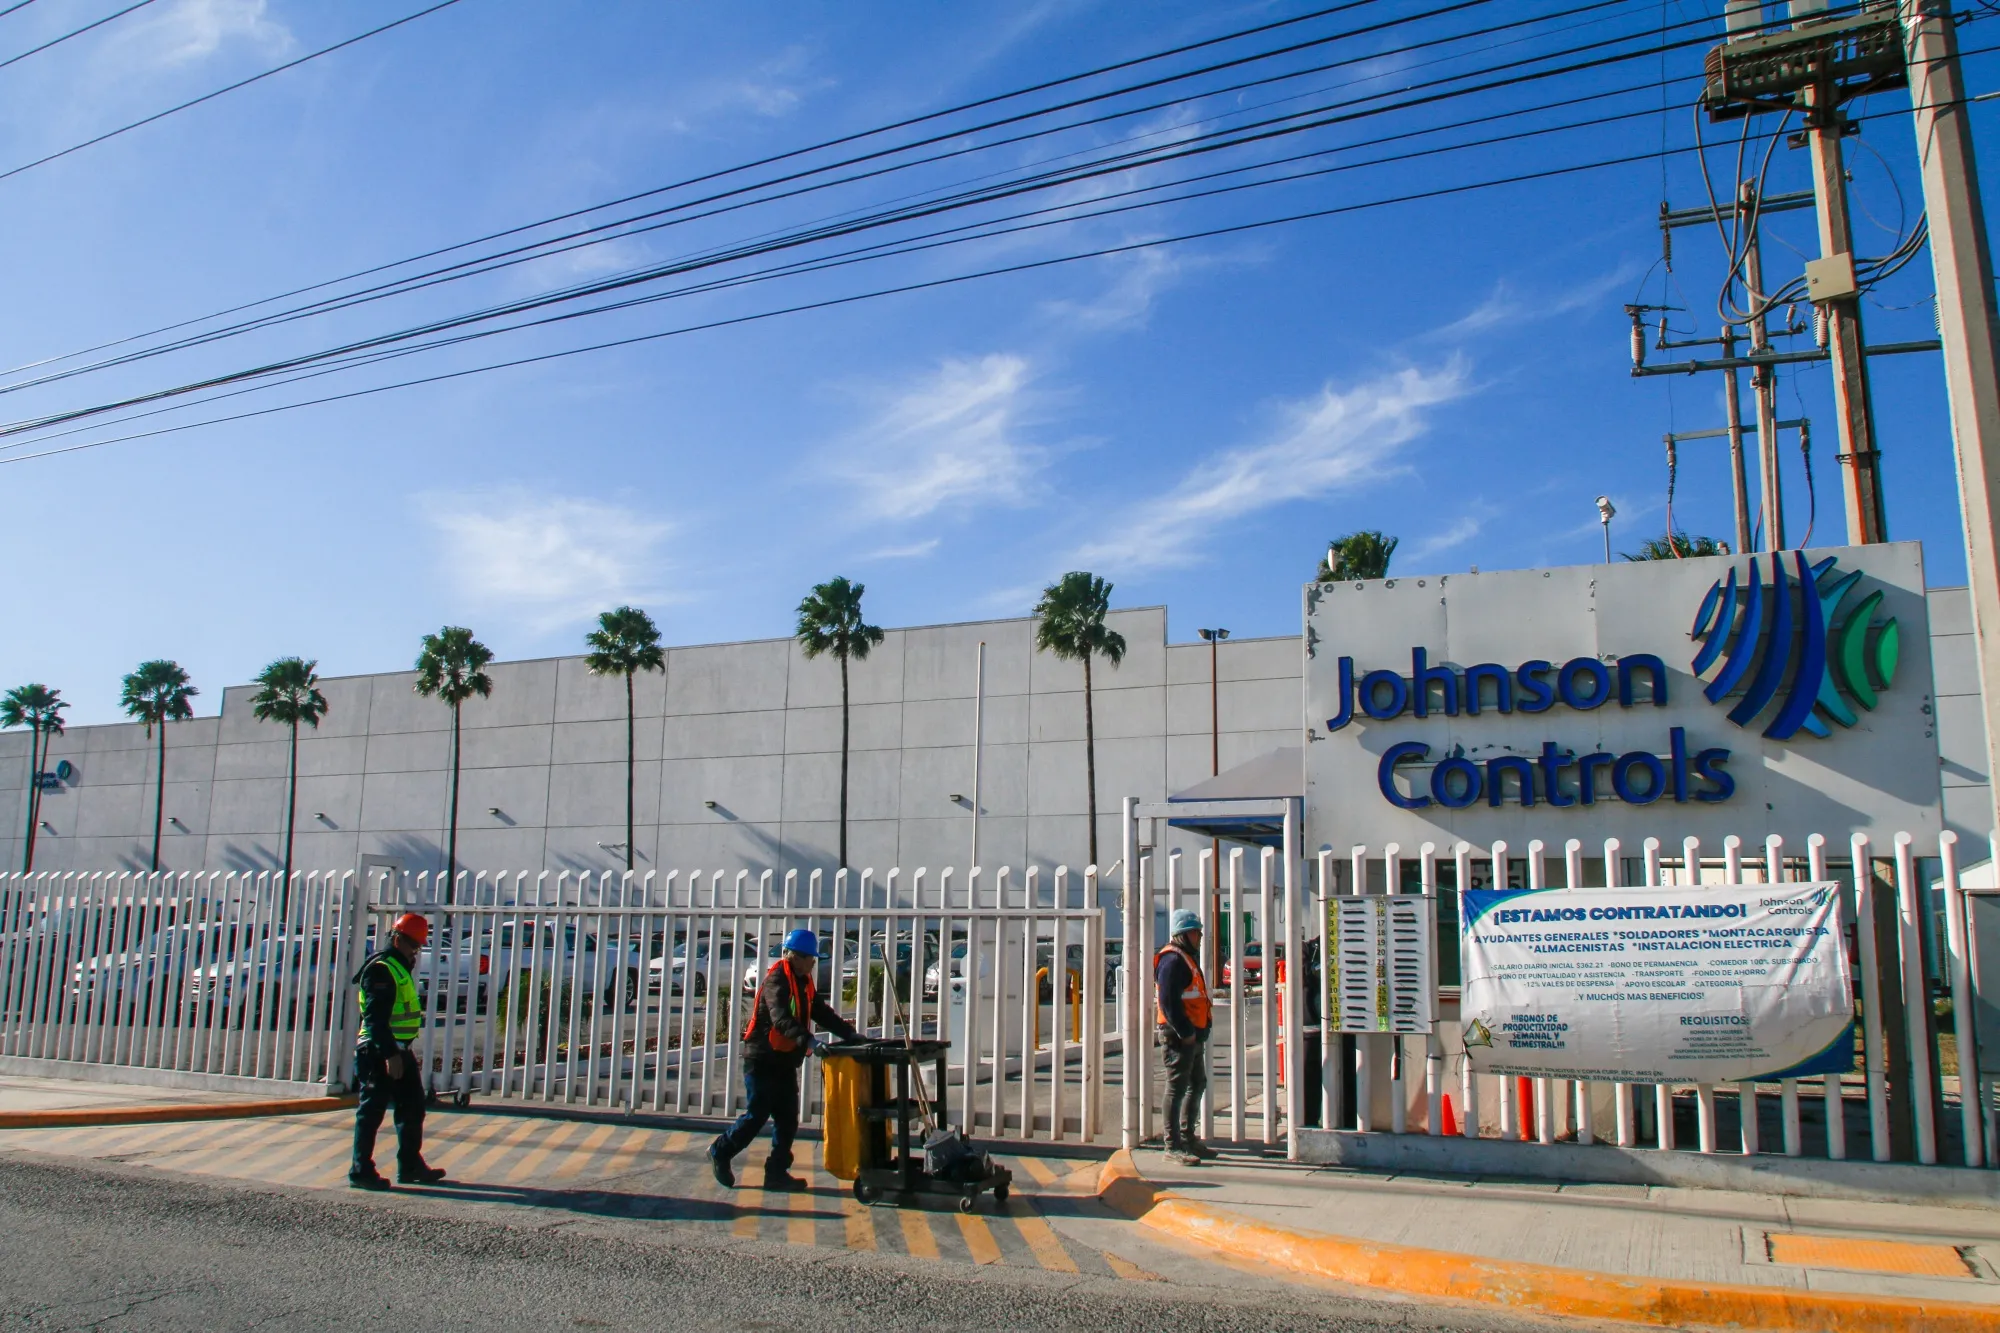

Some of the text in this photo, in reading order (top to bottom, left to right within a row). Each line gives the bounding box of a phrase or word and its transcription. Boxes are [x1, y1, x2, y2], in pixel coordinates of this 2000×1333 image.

[1326, 646, 1668, 733] Johnson
[1377, 726, 1737, 810] Controls
[1759, 898, 1803, 907] Johnson
[1493, 903, 1746, 926] ¡ESTAMOS CONTRATANDO!
[1768, 906, 1813, 916] Controls
[1544, 931, 1609, 942] GENERALES
[1724, 938, 1793, 950] ELECTRICA
[1644, 960, 1698, 968] PERMANENCIA
[1772, 958, 1818, 966] SUBSIDIADO
[1632, 970, 1684, 978] -TRANSPORTE
[1692, 980, 1744, 988] -CATEGORIAS
[1586, 993, 1624, 1001] MUCHOS
[1627, 992, 1648, 1000] MAS
[1650, 992, 1705, 1000] BENEFICIOS!
[1546, 1014, 1558, 1022] DE
[1680, 1016, 1750, 1026] REQUISITOS:
[1502, 1023, 1568, 1032] PRODUCTIVIDAD
[1512, 1032, 1560, 1040] SEMANAL Y
[1508, 1040, 1565, 1049] TRIMESTRAL!!!
